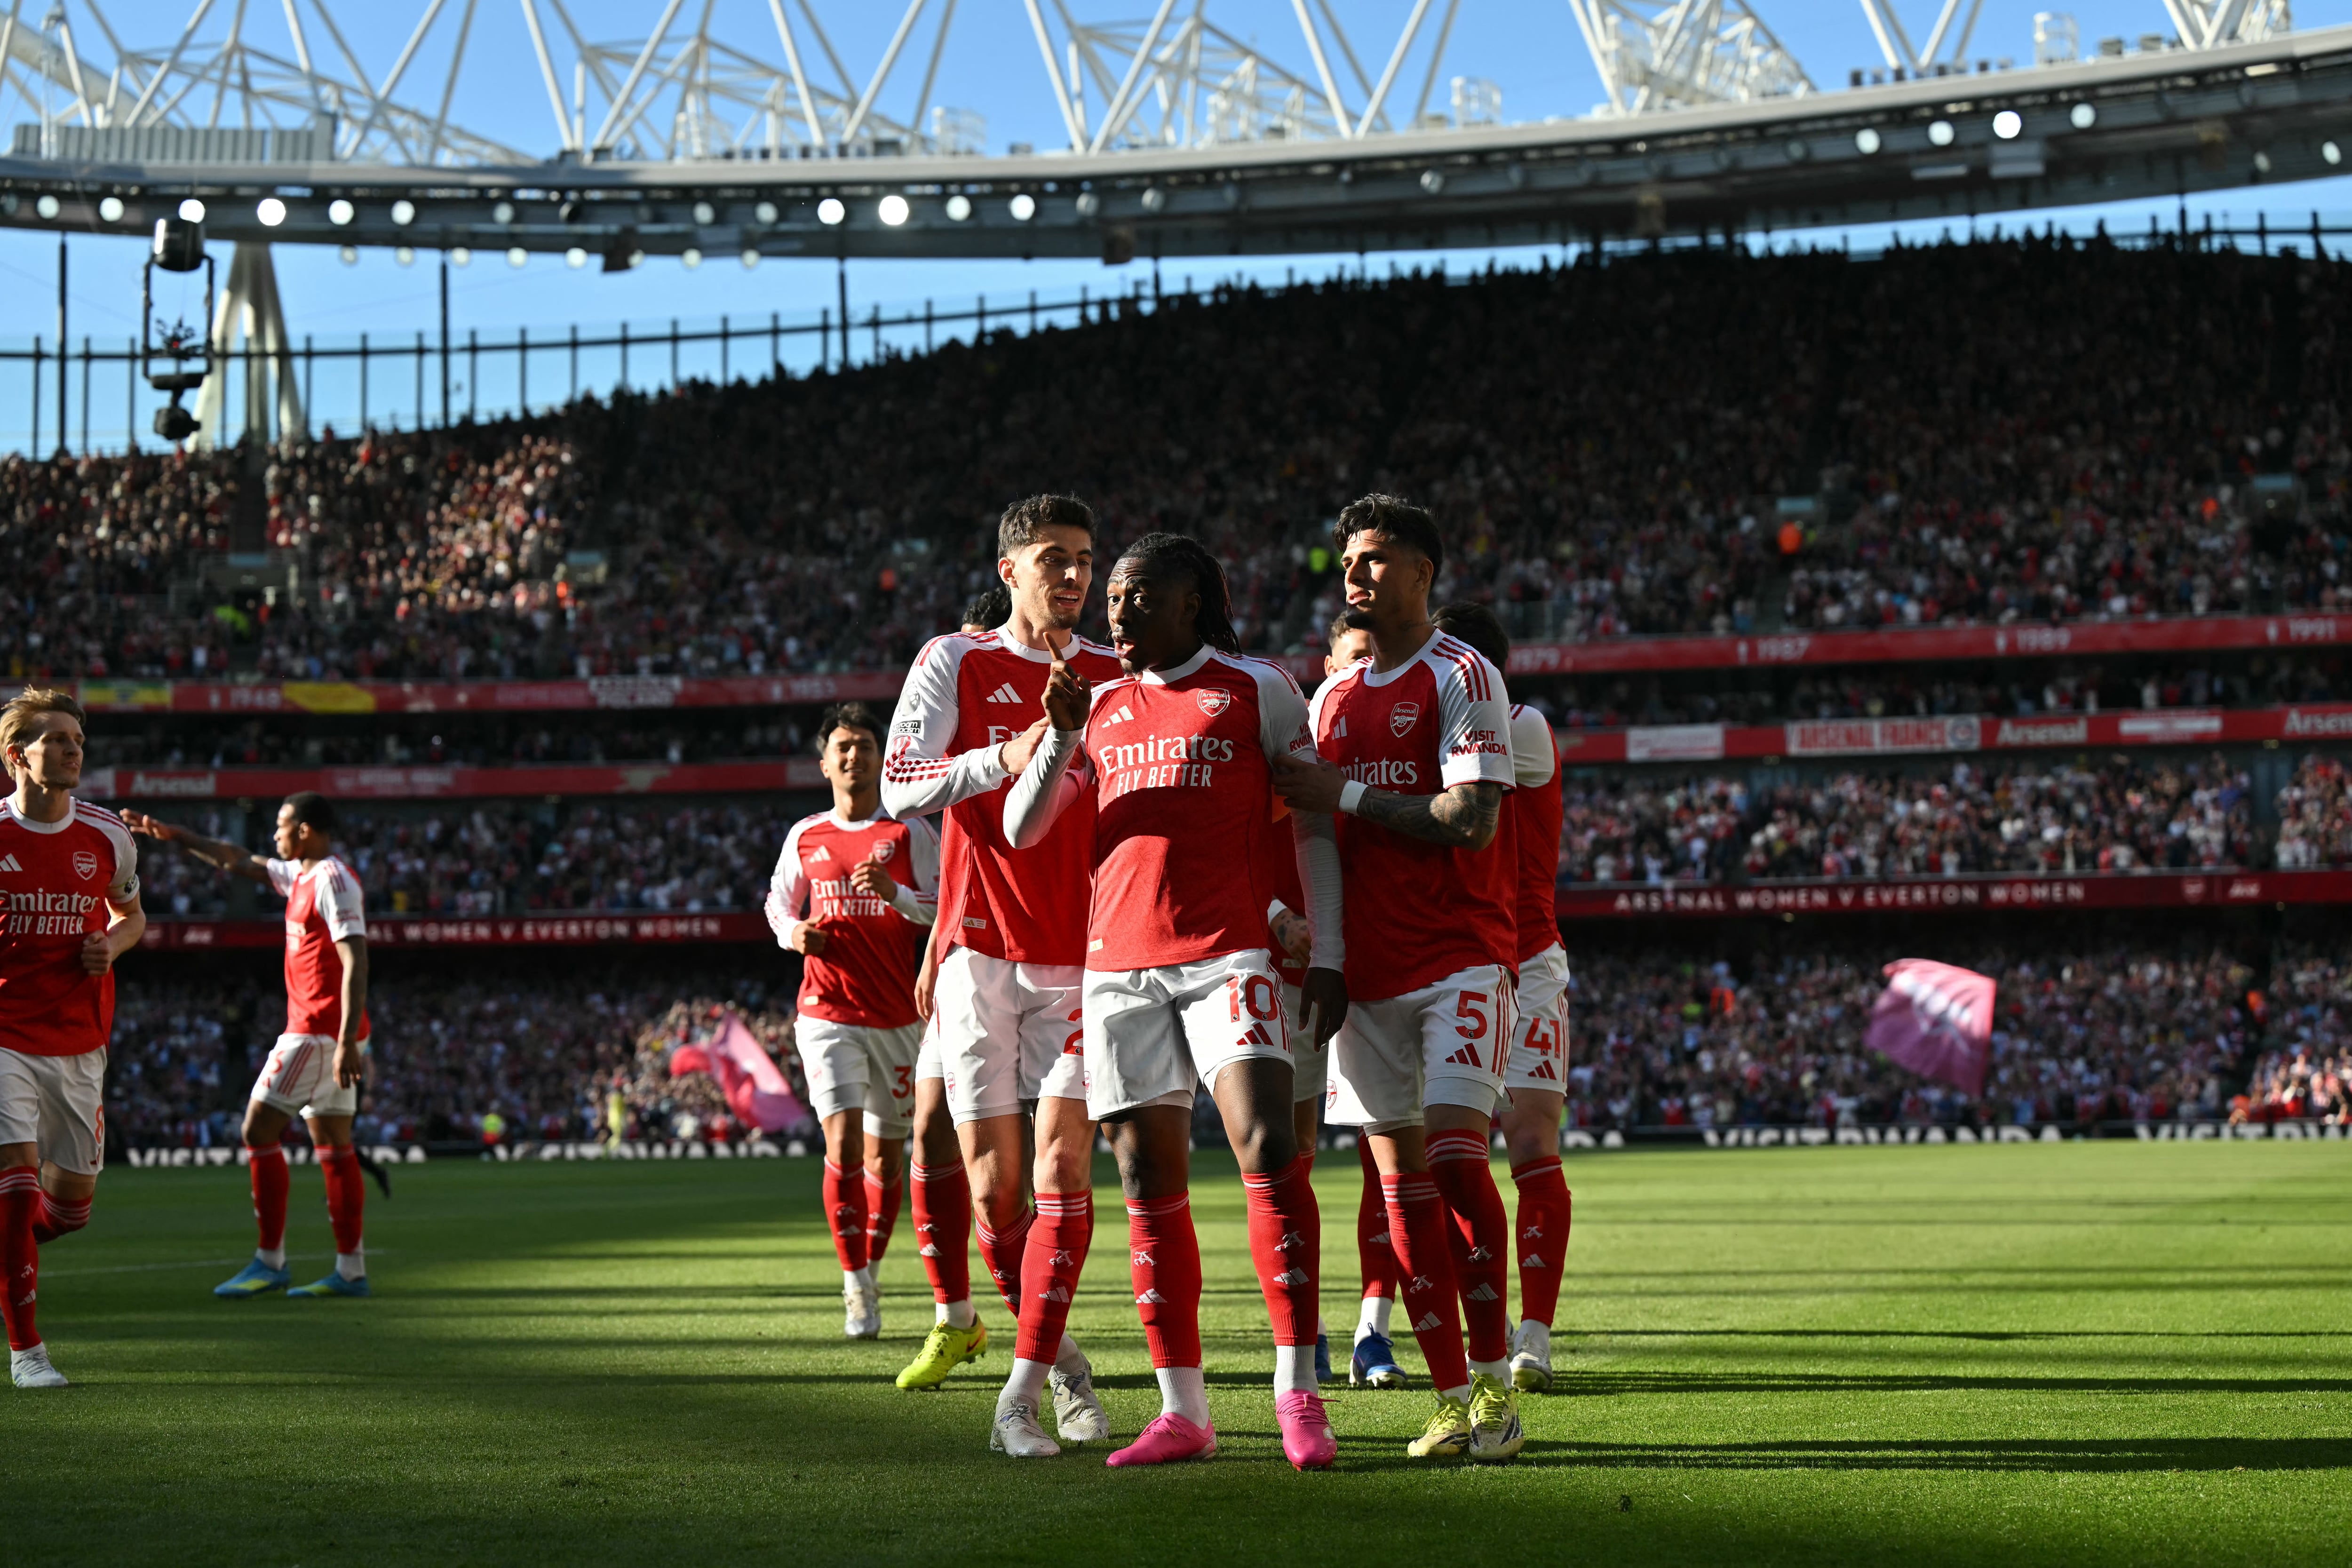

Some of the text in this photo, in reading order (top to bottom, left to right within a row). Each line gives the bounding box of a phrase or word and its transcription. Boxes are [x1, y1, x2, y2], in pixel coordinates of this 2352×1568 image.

[2017, 627, 2072, 652] 1989
[2289, 618, 2336, 641] 1991
[1510, 647, 1561, 671] 1979
[1757, 637, 1810, 662] 1987
[1289, 732, 1314, 752] RWAN
[1463, 730, 1495, 742] VISIT
[1996, 717, 2087, 745] Arsenal
[1098, 732, 1233, 776] Emirates
[1451, 743, 1507, 757] RWANDA
[1117, 764, 1212, 797] FLY BETTER
[1340, 756, 1417, 785] mirates
[130, 772, 215, 796] Arsenal
[823, 899, 885, 916] FLY BETTER
[1613, 882, 2084, 912] ARSNAL WOMEN V EVERTON WOMEN
[9, 915, 84, 934] FLY BETTER
[403, 923, 492, 942] WOMEN
[498, 922, 516, 941] V
[522, 919, 630, 940] EVERTON
[636, 917, 721, 939] WOMEN
[1226, 975, 1279, 1023] 10
[1455, 990, 1488, 1039] 5
[1524, 1018, 1561, 1059] 41
[892, 1066, 915, 1099] 3
